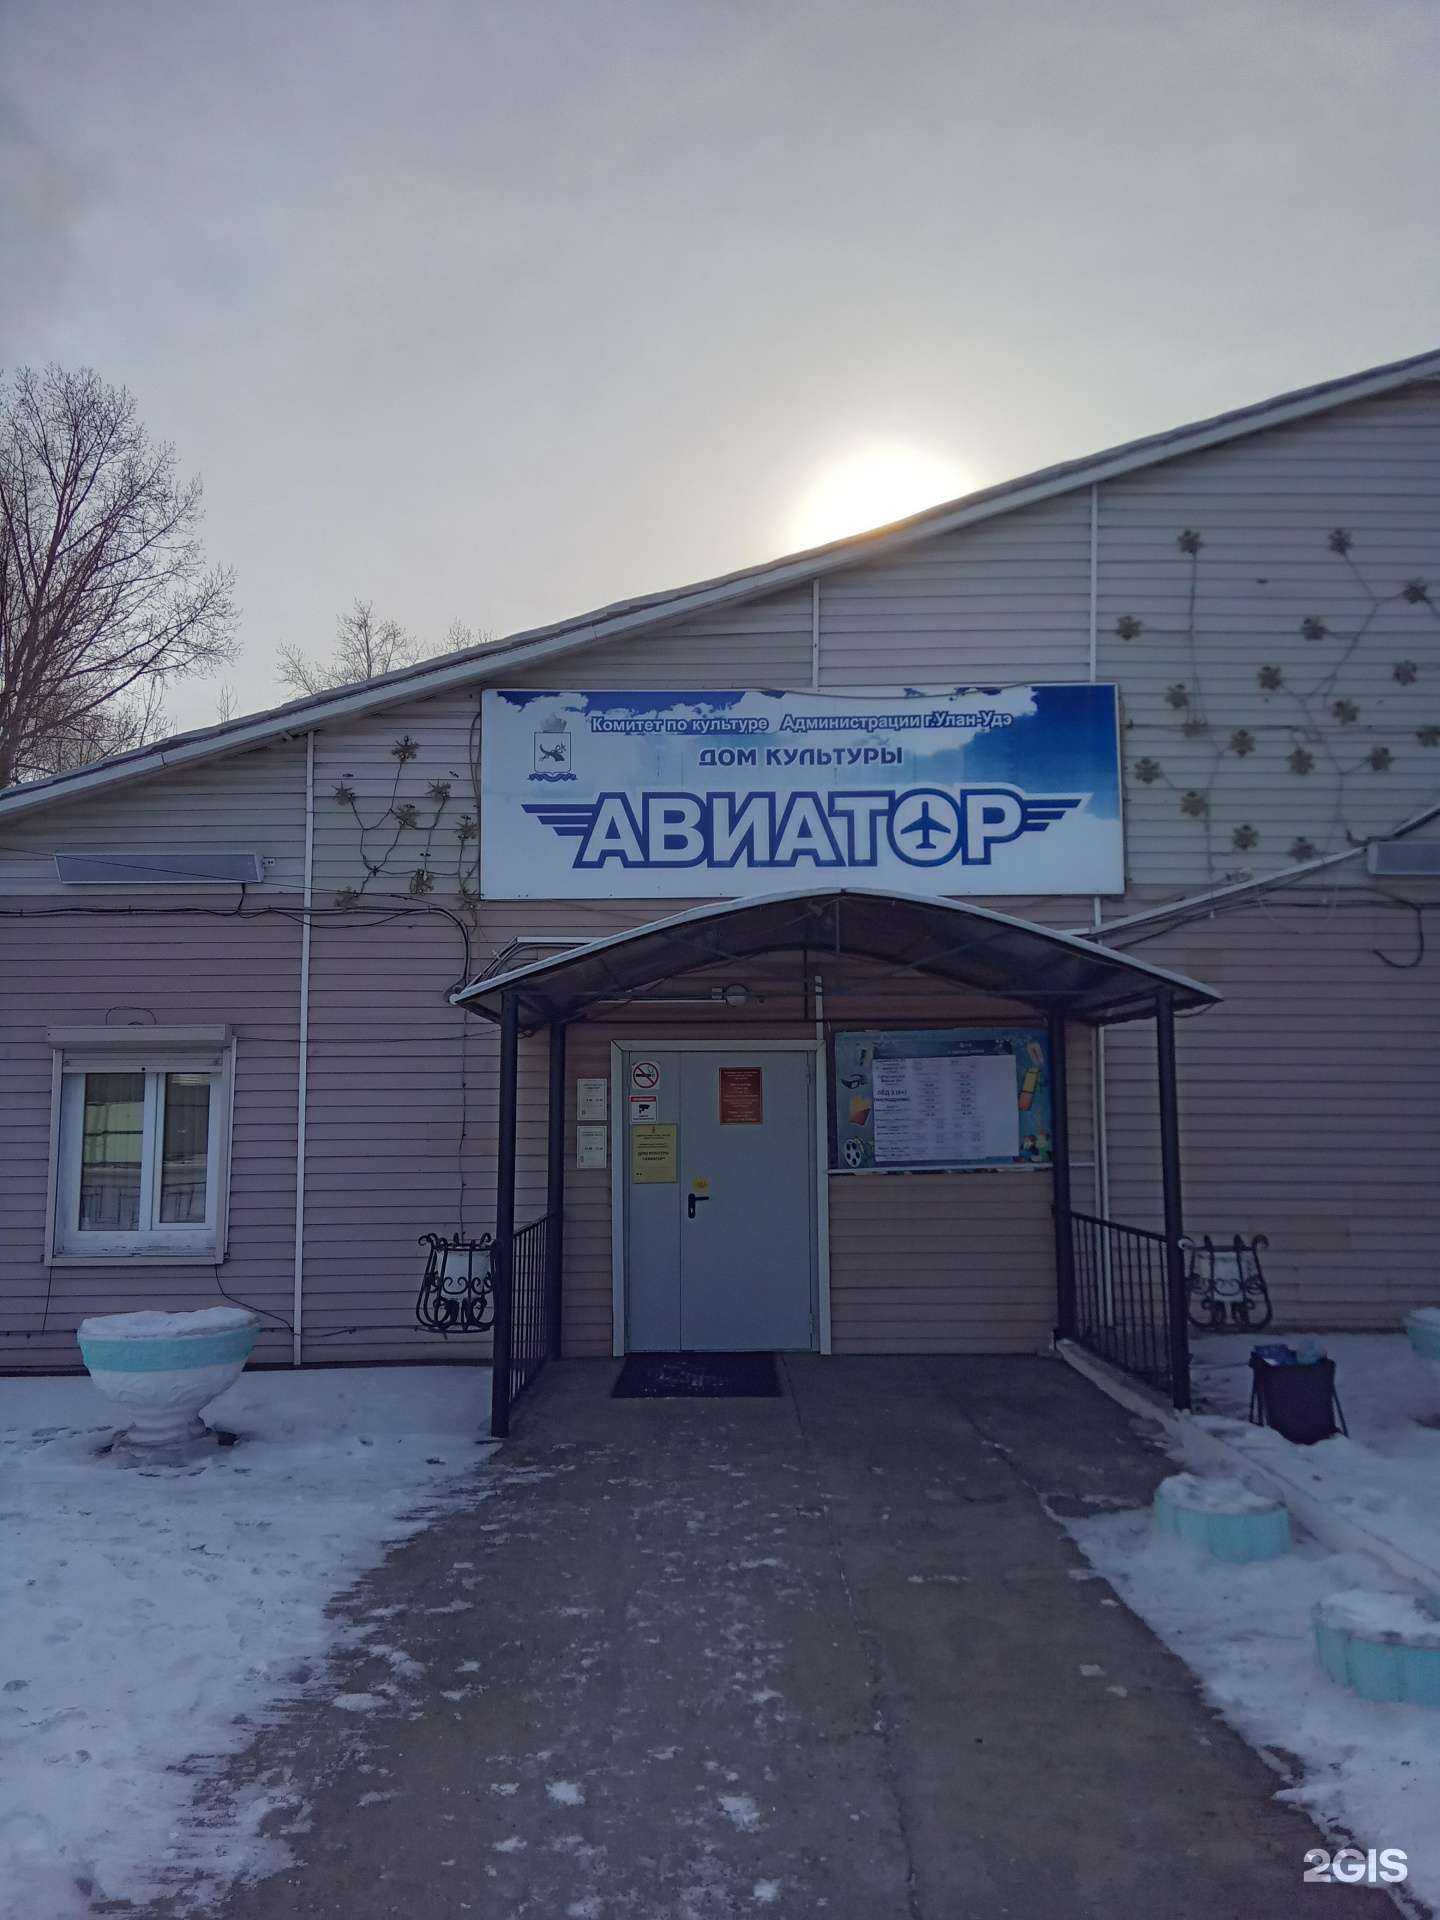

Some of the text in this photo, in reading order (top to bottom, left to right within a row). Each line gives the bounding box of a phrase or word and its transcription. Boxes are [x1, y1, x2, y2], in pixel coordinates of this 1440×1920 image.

[591, 716, 663, 733] Комитет
[665, 718, 689, 733] по
[691, 717, 769, 735] культуре
[780, 713, 921, 732] Администрации
[699, 747, 902, 766] ДОМ КУЛЬТУРЫ
[572, 787, 1025, 869] АВИАТОР
